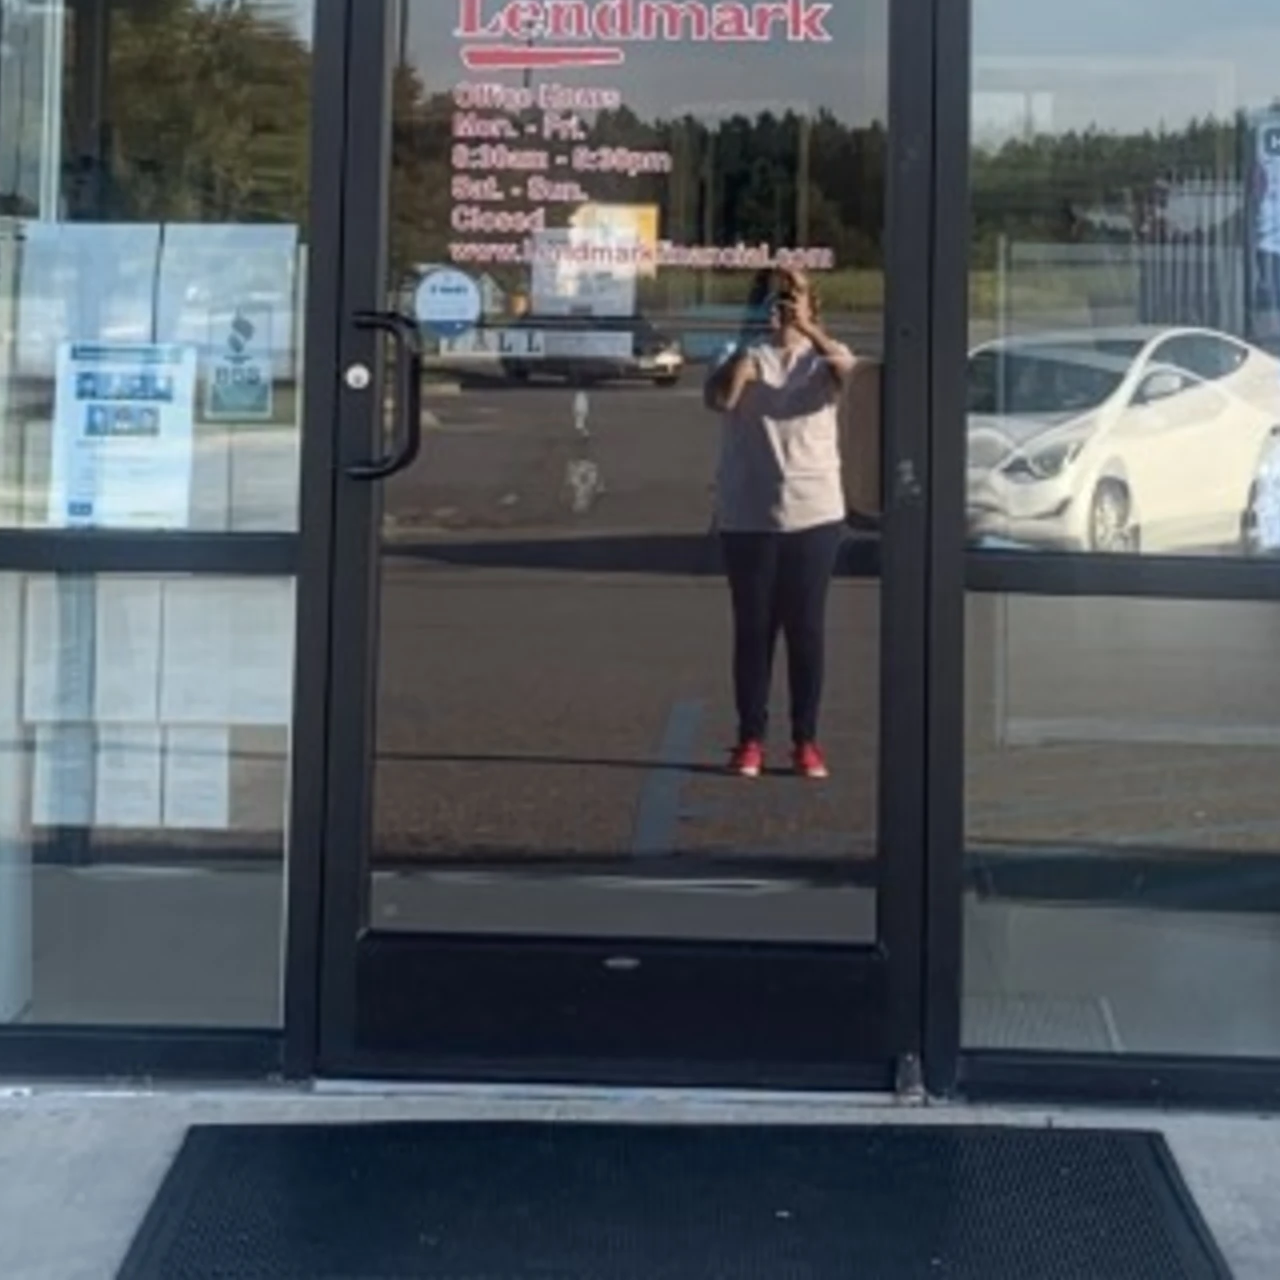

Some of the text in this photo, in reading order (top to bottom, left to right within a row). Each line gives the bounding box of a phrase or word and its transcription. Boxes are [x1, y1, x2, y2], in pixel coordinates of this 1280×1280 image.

[451, 175, 504, 200] Sat.
[527, 176, 588, 201] Sun.
[451, 205, 545, 233] Closed
